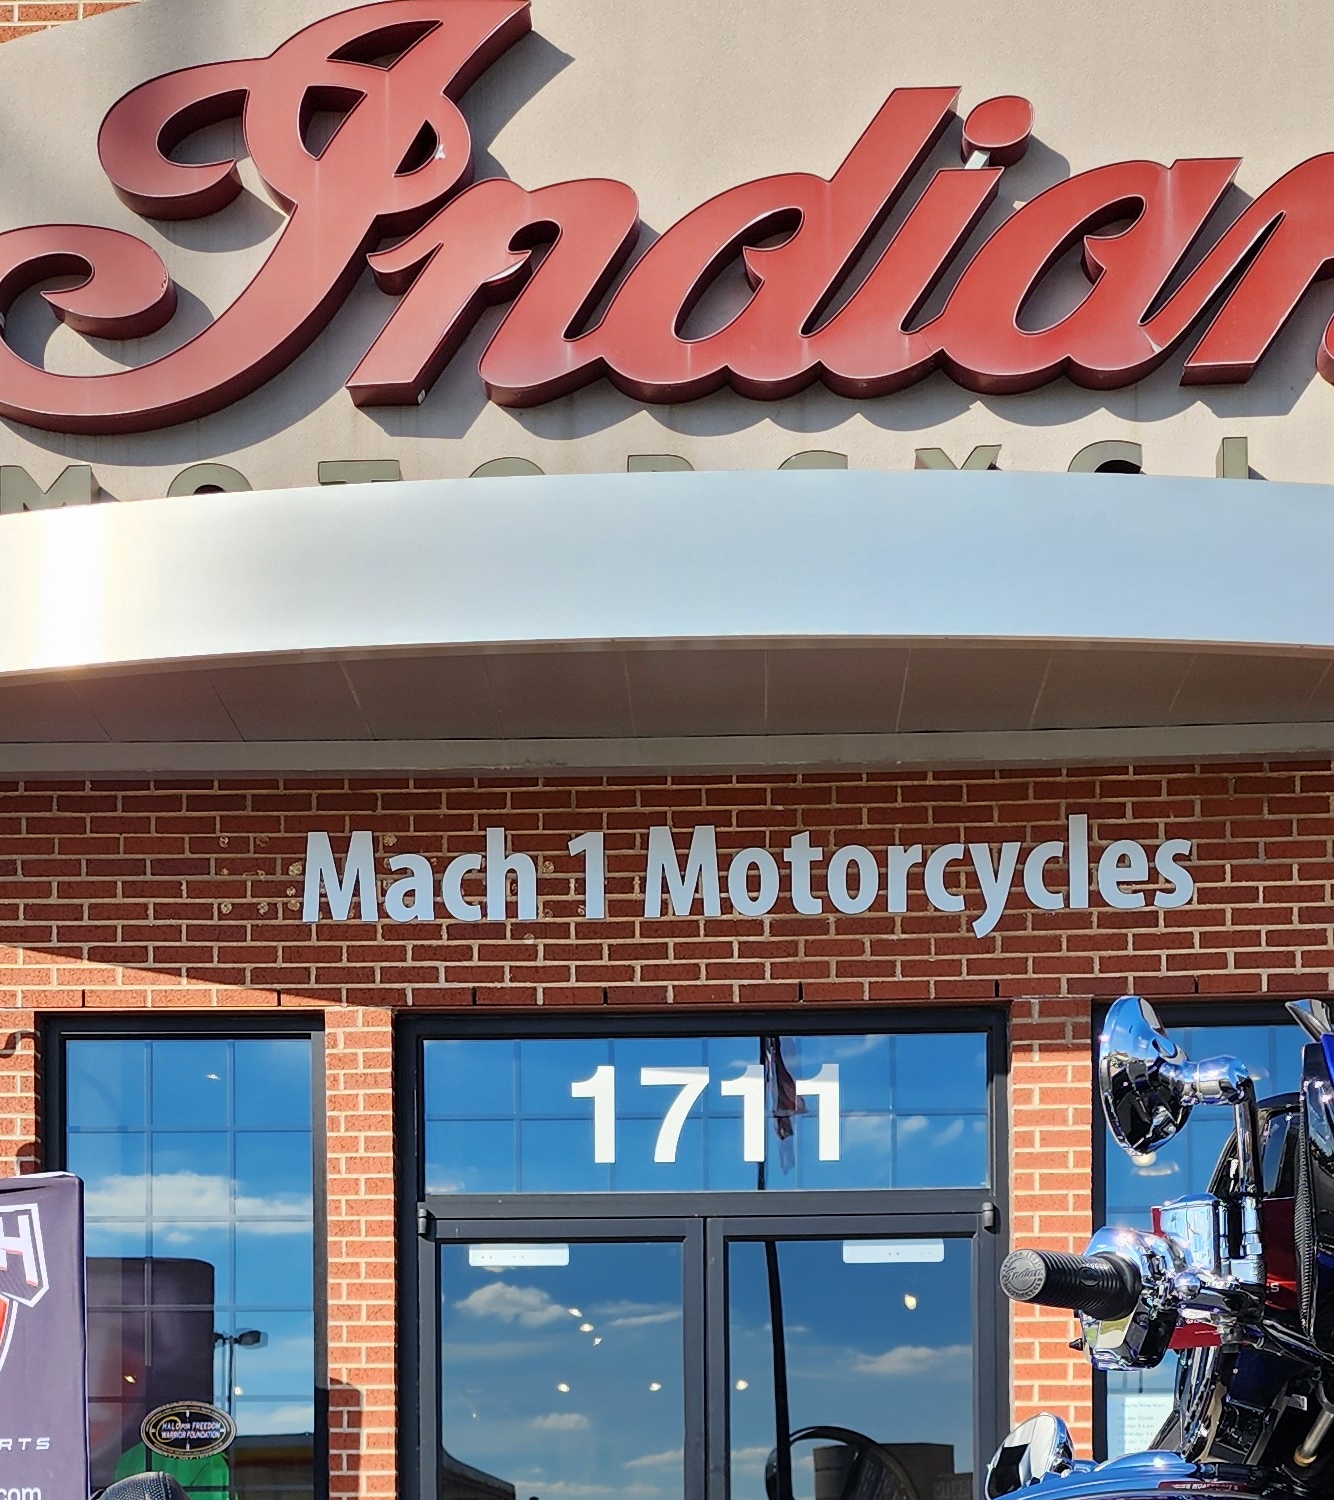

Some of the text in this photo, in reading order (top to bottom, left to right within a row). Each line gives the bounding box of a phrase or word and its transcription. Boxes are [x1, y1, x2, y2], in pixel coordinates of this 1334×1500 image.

[301, 814, 1195, 938] Mach 1 Motorcycles
[571, 1063, 842, 1164] 1711
[191, 1421, 221, 1431] FREEDOM
